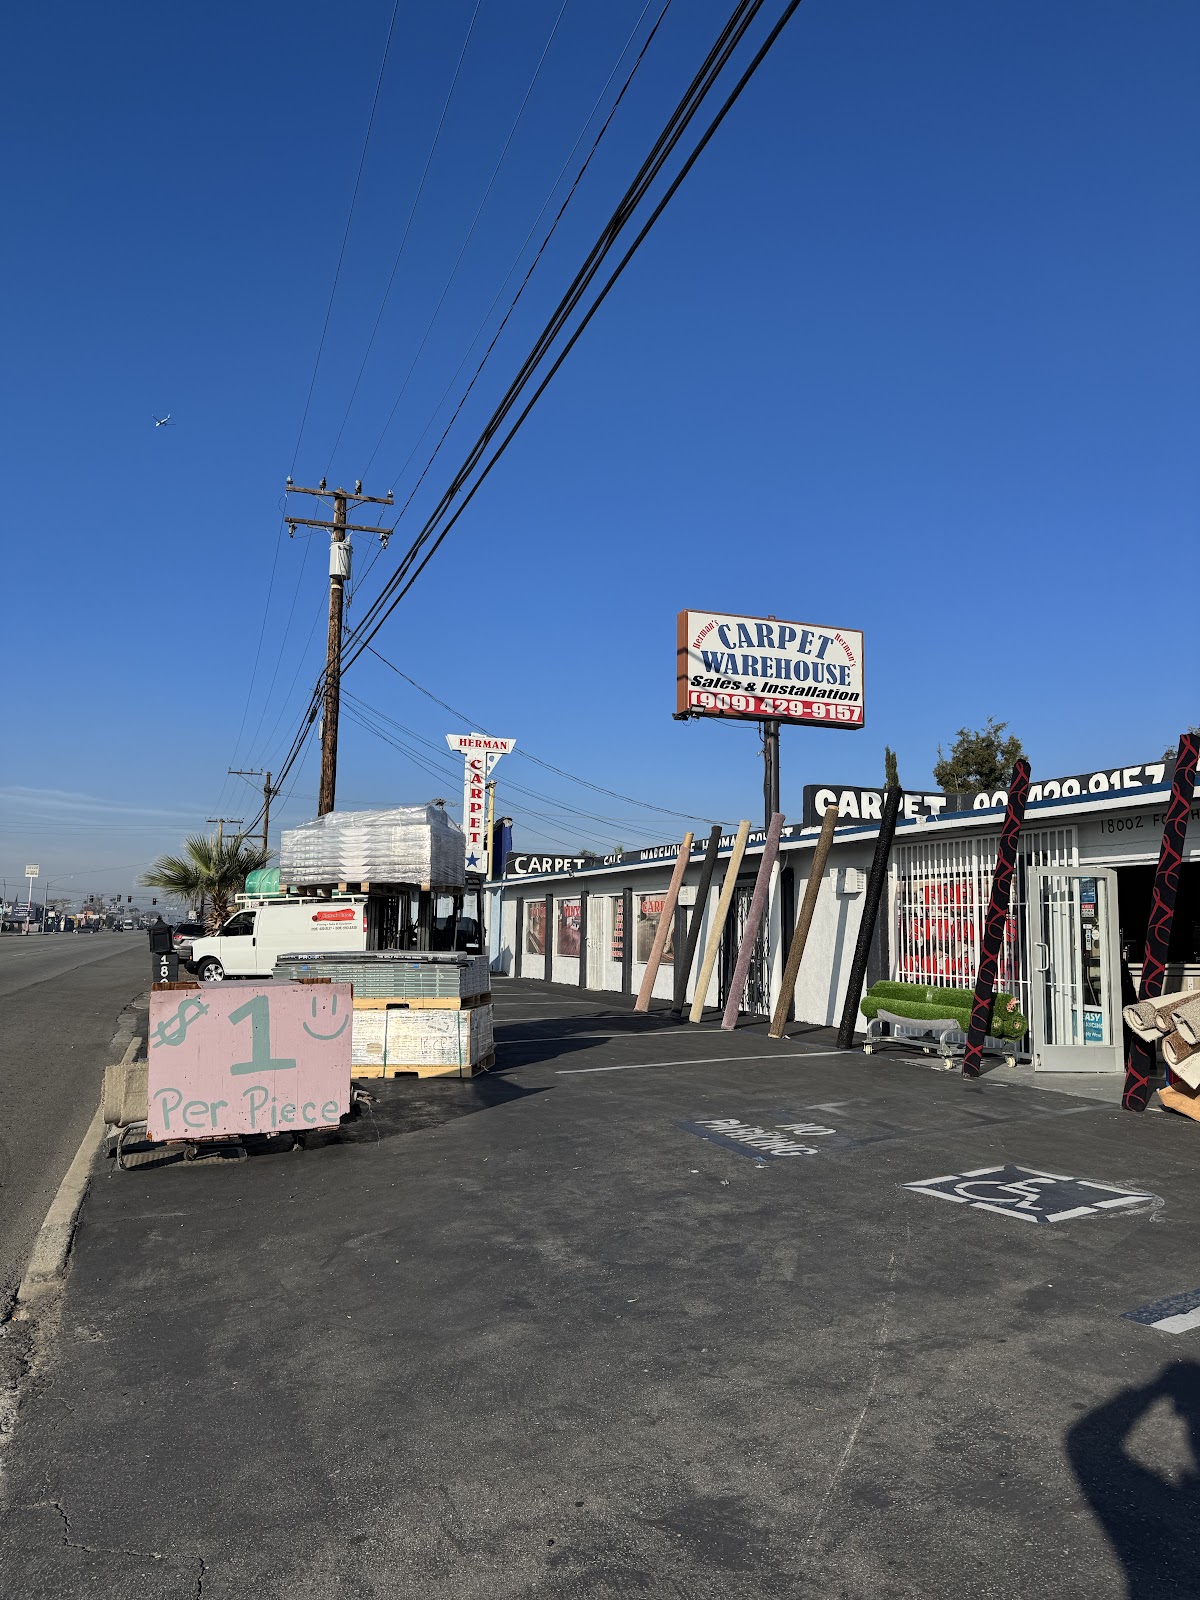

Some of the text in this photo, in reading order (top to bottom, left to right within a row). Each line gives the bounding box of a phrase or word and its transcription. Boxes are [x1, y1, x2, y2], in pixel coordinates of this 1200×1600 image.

[692, 618, 719, 650] Herman's
[717, 621, 836, 660] CARPET
[834, 633, 857, 668] Herman's
[700, 650, 851, 687] WAREHOUSE
[690, 675, 860, 702] Sales & Installation
[760, 698, 862, 721] 429-9157
[459, 738, 507, 750] HERMAN
[470, 759, 482, 843] CARPET
[1100, 815, 1144, 834] 18002
[514, 856, 586, 874] CARPET
[1084, 1012, 1101, 1022] ASY
[153, 1085, 340, 1130] Per Piece
[694, 1118, 819, 1156] PARKING
[775, 1123, 837, 1136] NO
